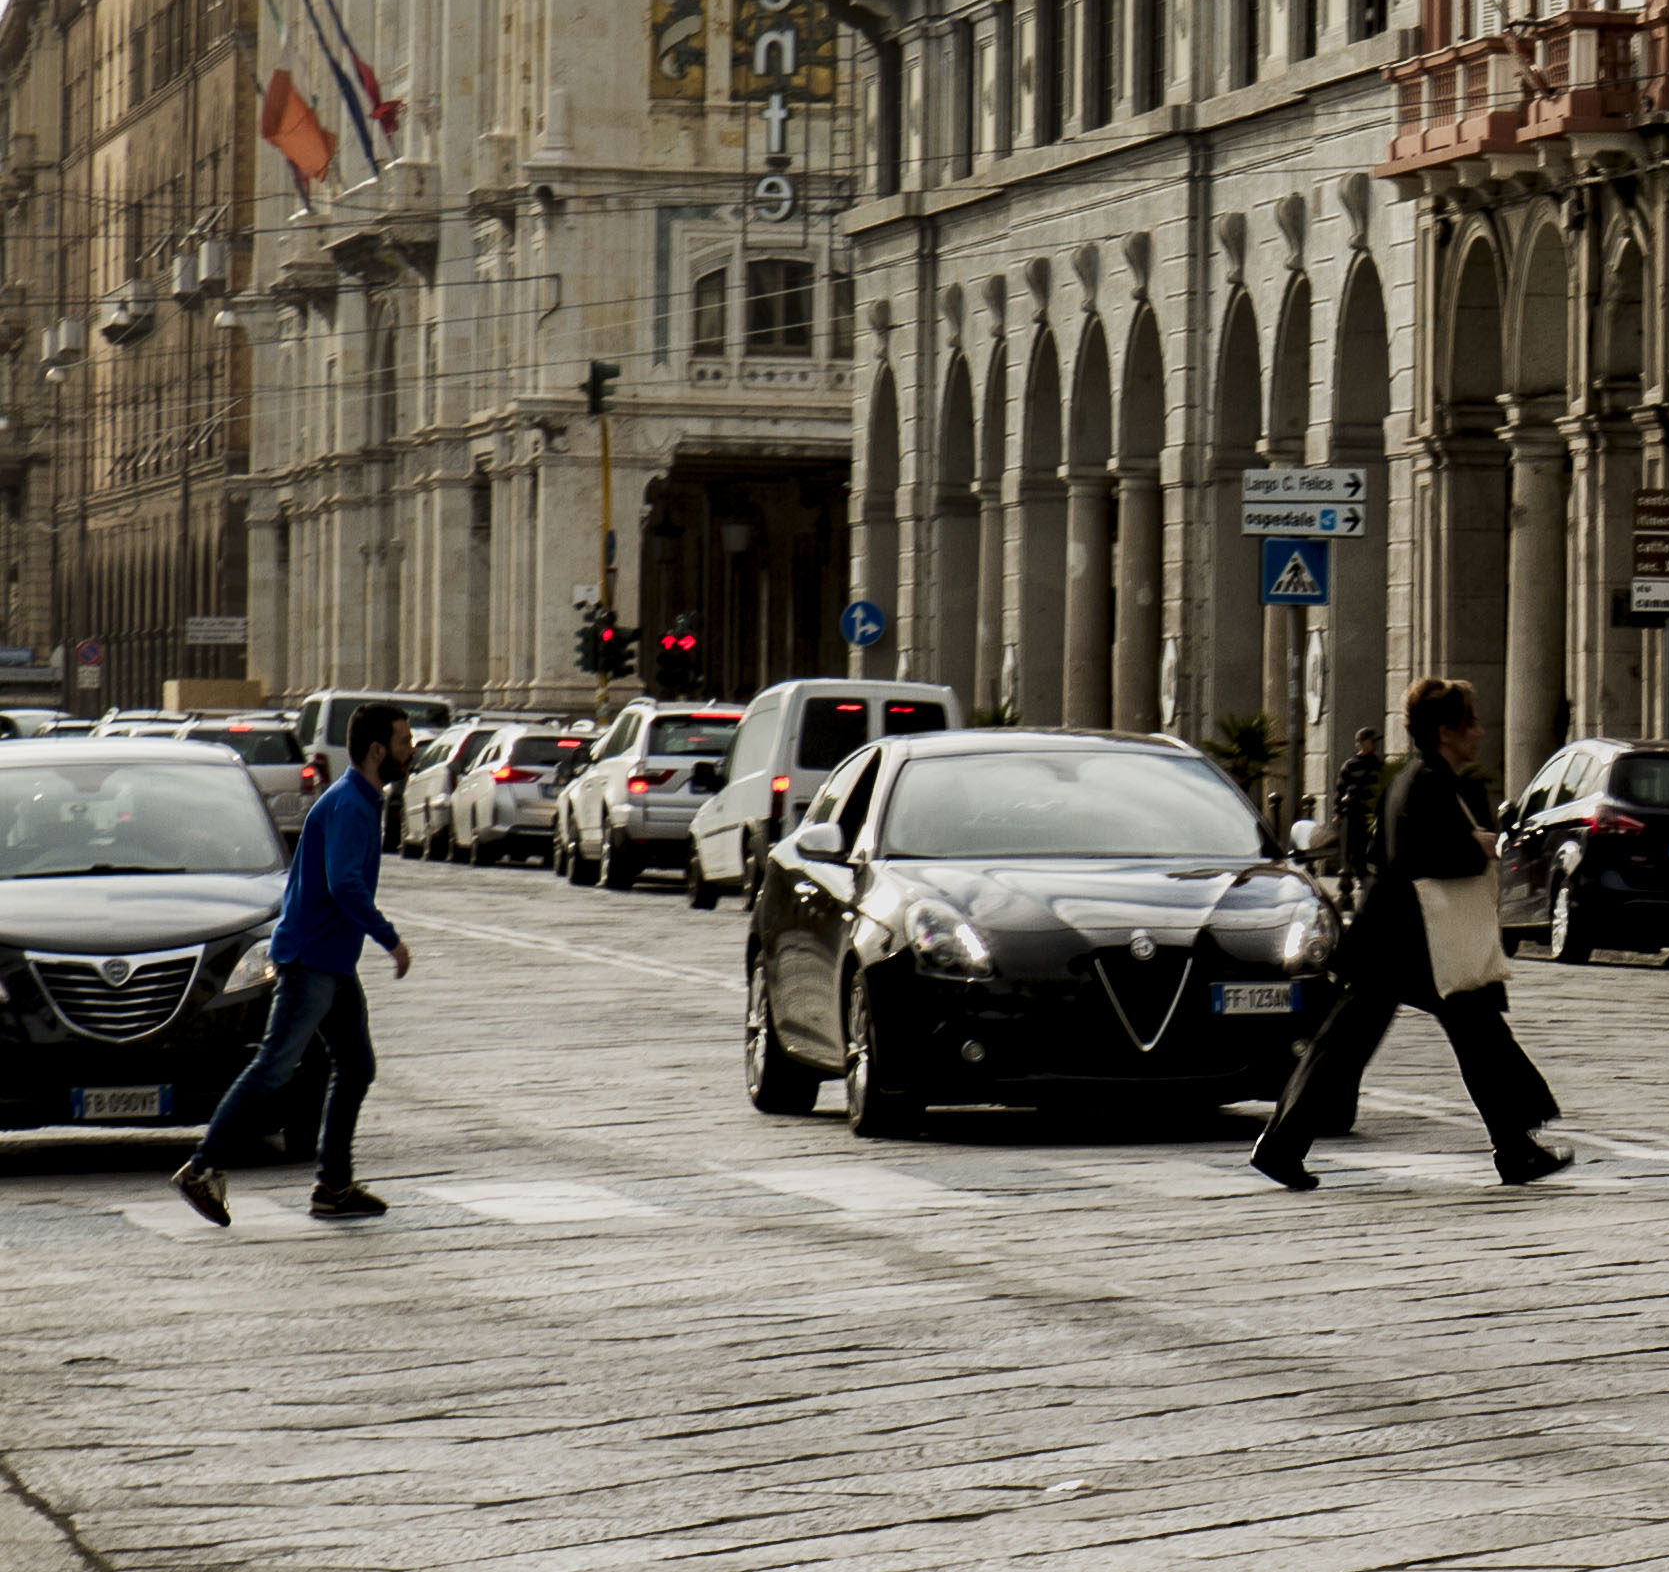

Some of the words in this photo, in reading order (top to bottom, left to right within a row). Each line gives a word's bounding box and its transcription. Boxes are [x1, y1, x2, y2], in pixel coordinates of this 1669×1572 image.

[1245, 475, 1278, 494] Largo
[1299, 475, 1335, 491] Felice
[1245, 510, 1316, 529] ospedale
